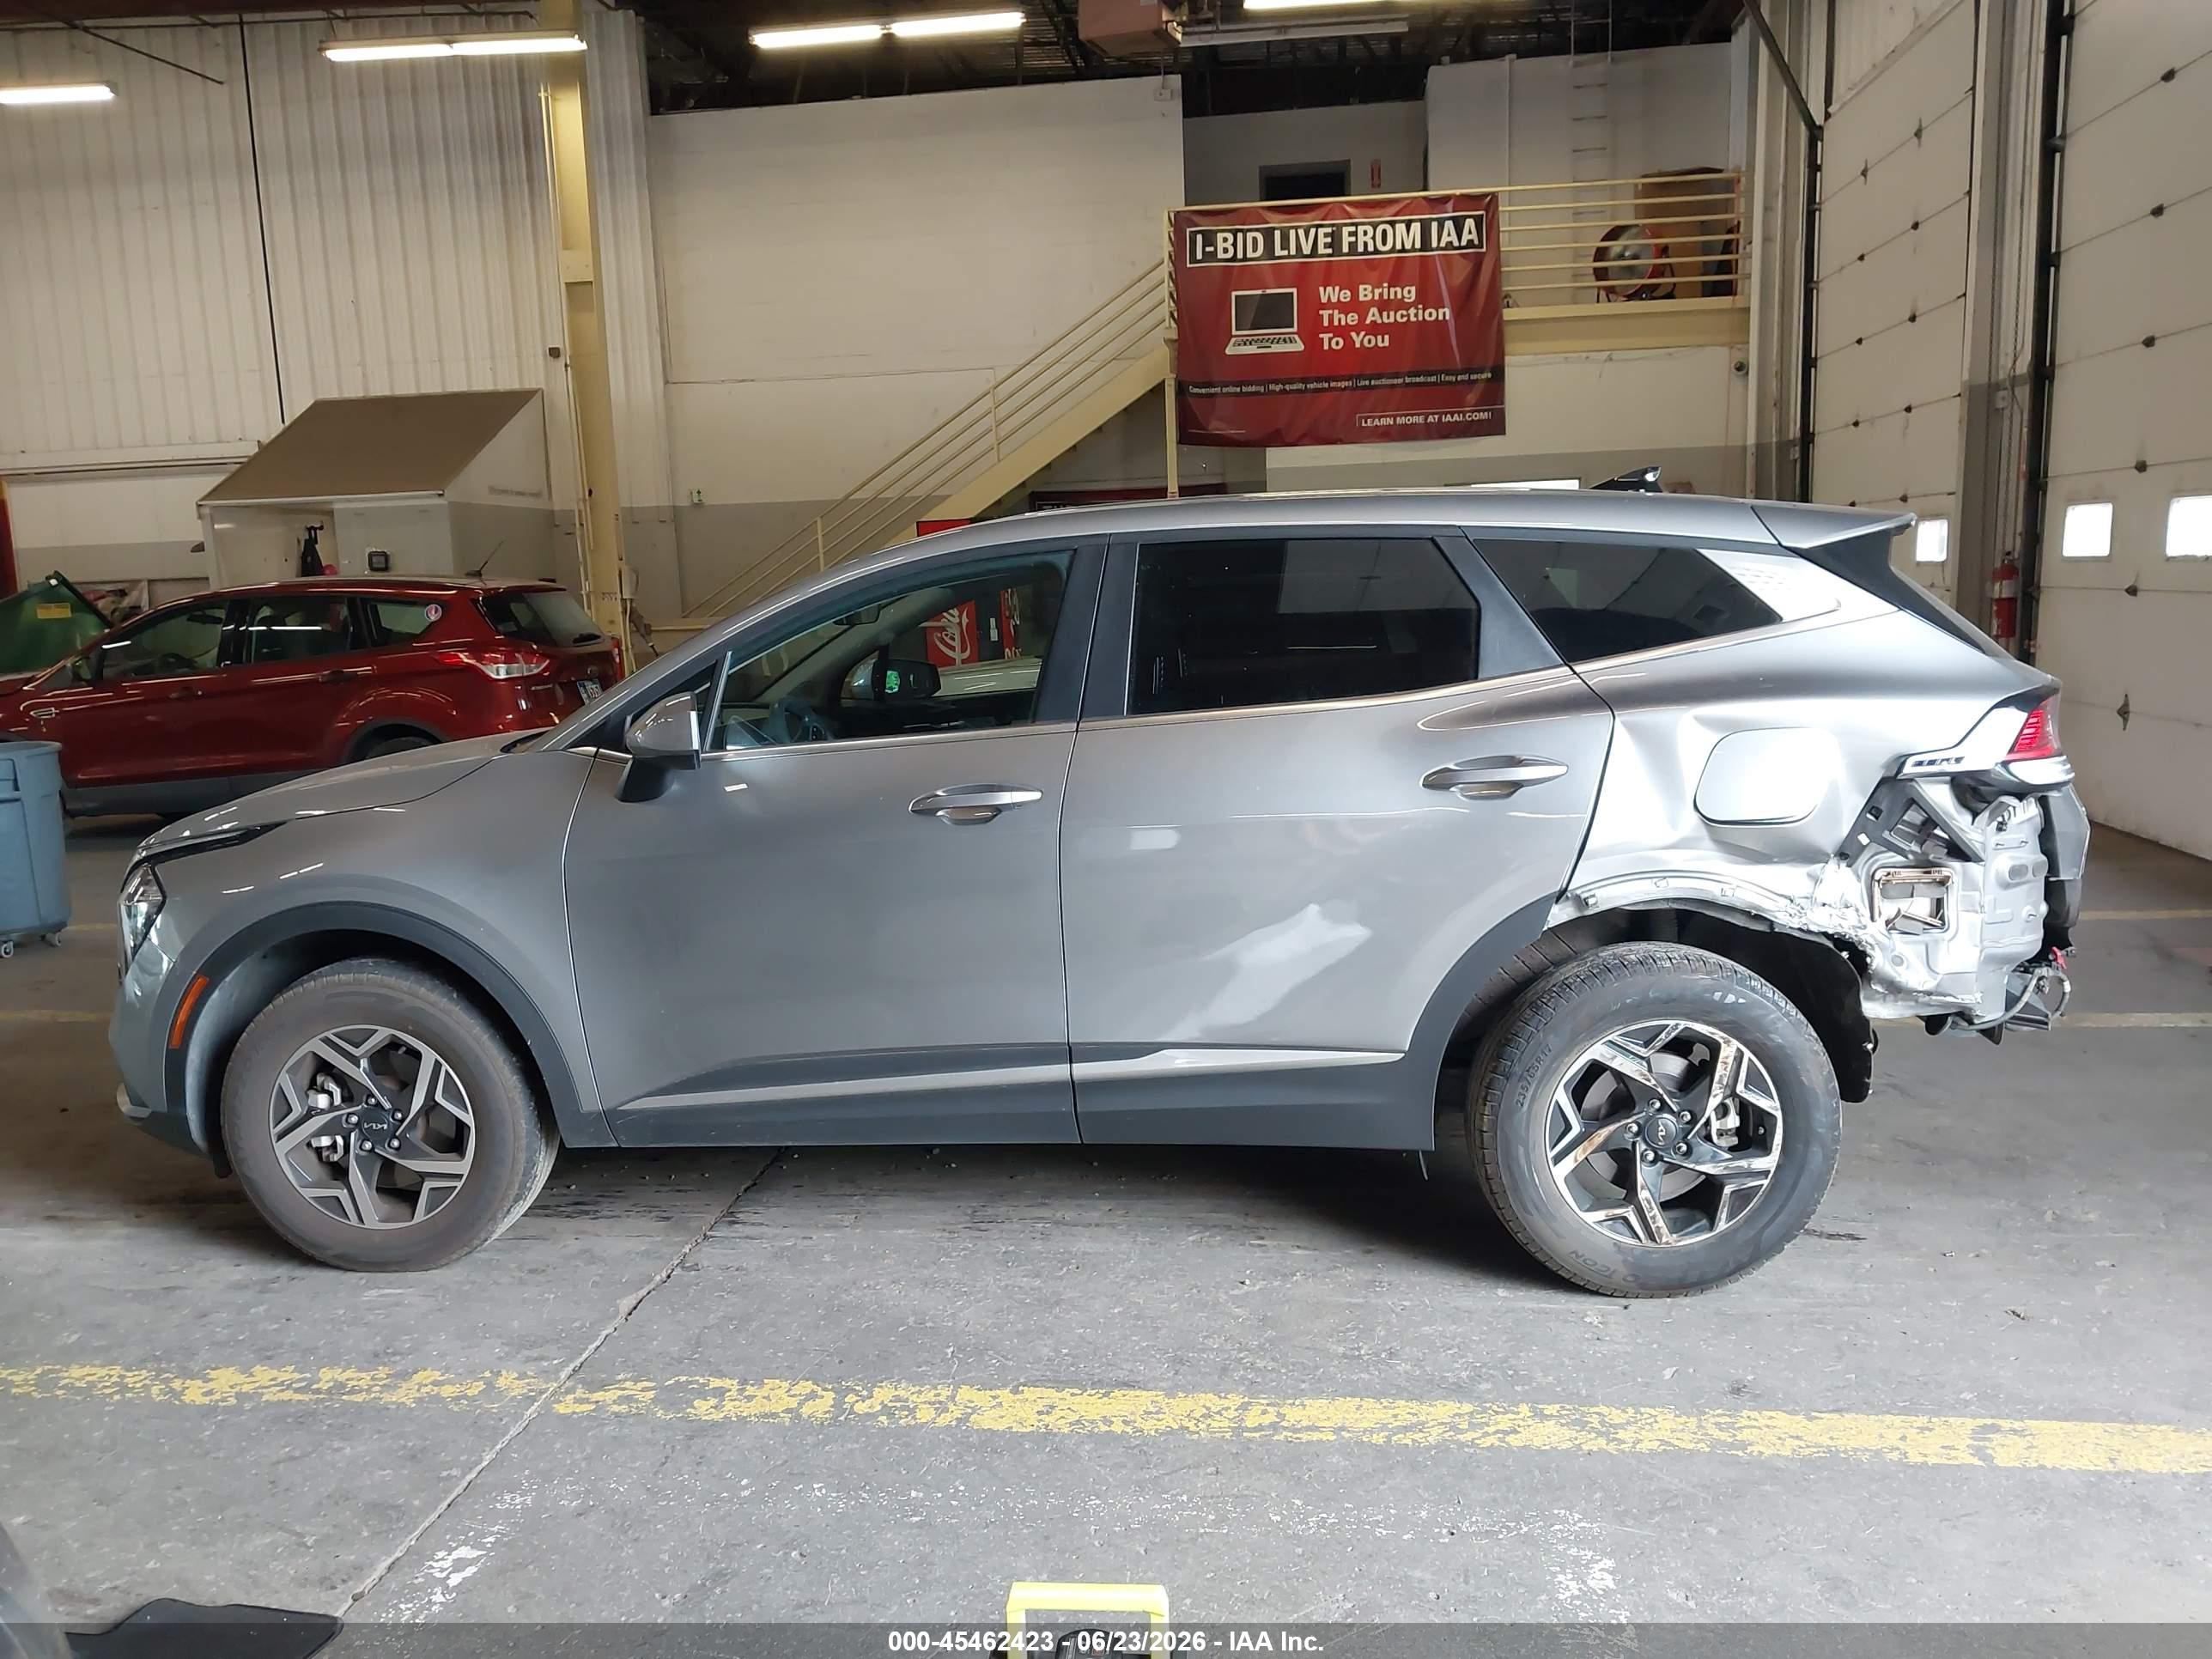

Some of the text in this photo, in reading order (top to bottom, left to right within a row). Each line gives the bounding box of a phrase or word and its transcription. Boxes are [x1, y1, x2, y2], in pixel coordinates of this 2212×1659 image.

[1195, 217, 1480, 260] I-BID LIVE FROM IAA
[1318, 283, 1416, 303] We Bring
[1318, 305, 1450, 327] The Auction
[1318, 331, 1390, 350] To You
[1188, 385, 1221, 393] Convenient
[1242, 384, 1265, 393] bidding
[1269, 382, 1305, 392] High-quality
[1306, 380, 1329, 390] vehicle
[1330, 380, 1352, 389] images
[1357, 378, 1370, 386] Live
[1405, 375, 1437, 384] broadcast
[1441, 374, 1456, 383] Easy
[1457, 372, 1469, 381] and
[1469, 371, 1492, 380] secure
[1361, 411, 1492, 428] LEARN MORE AT IAAI.COM!
